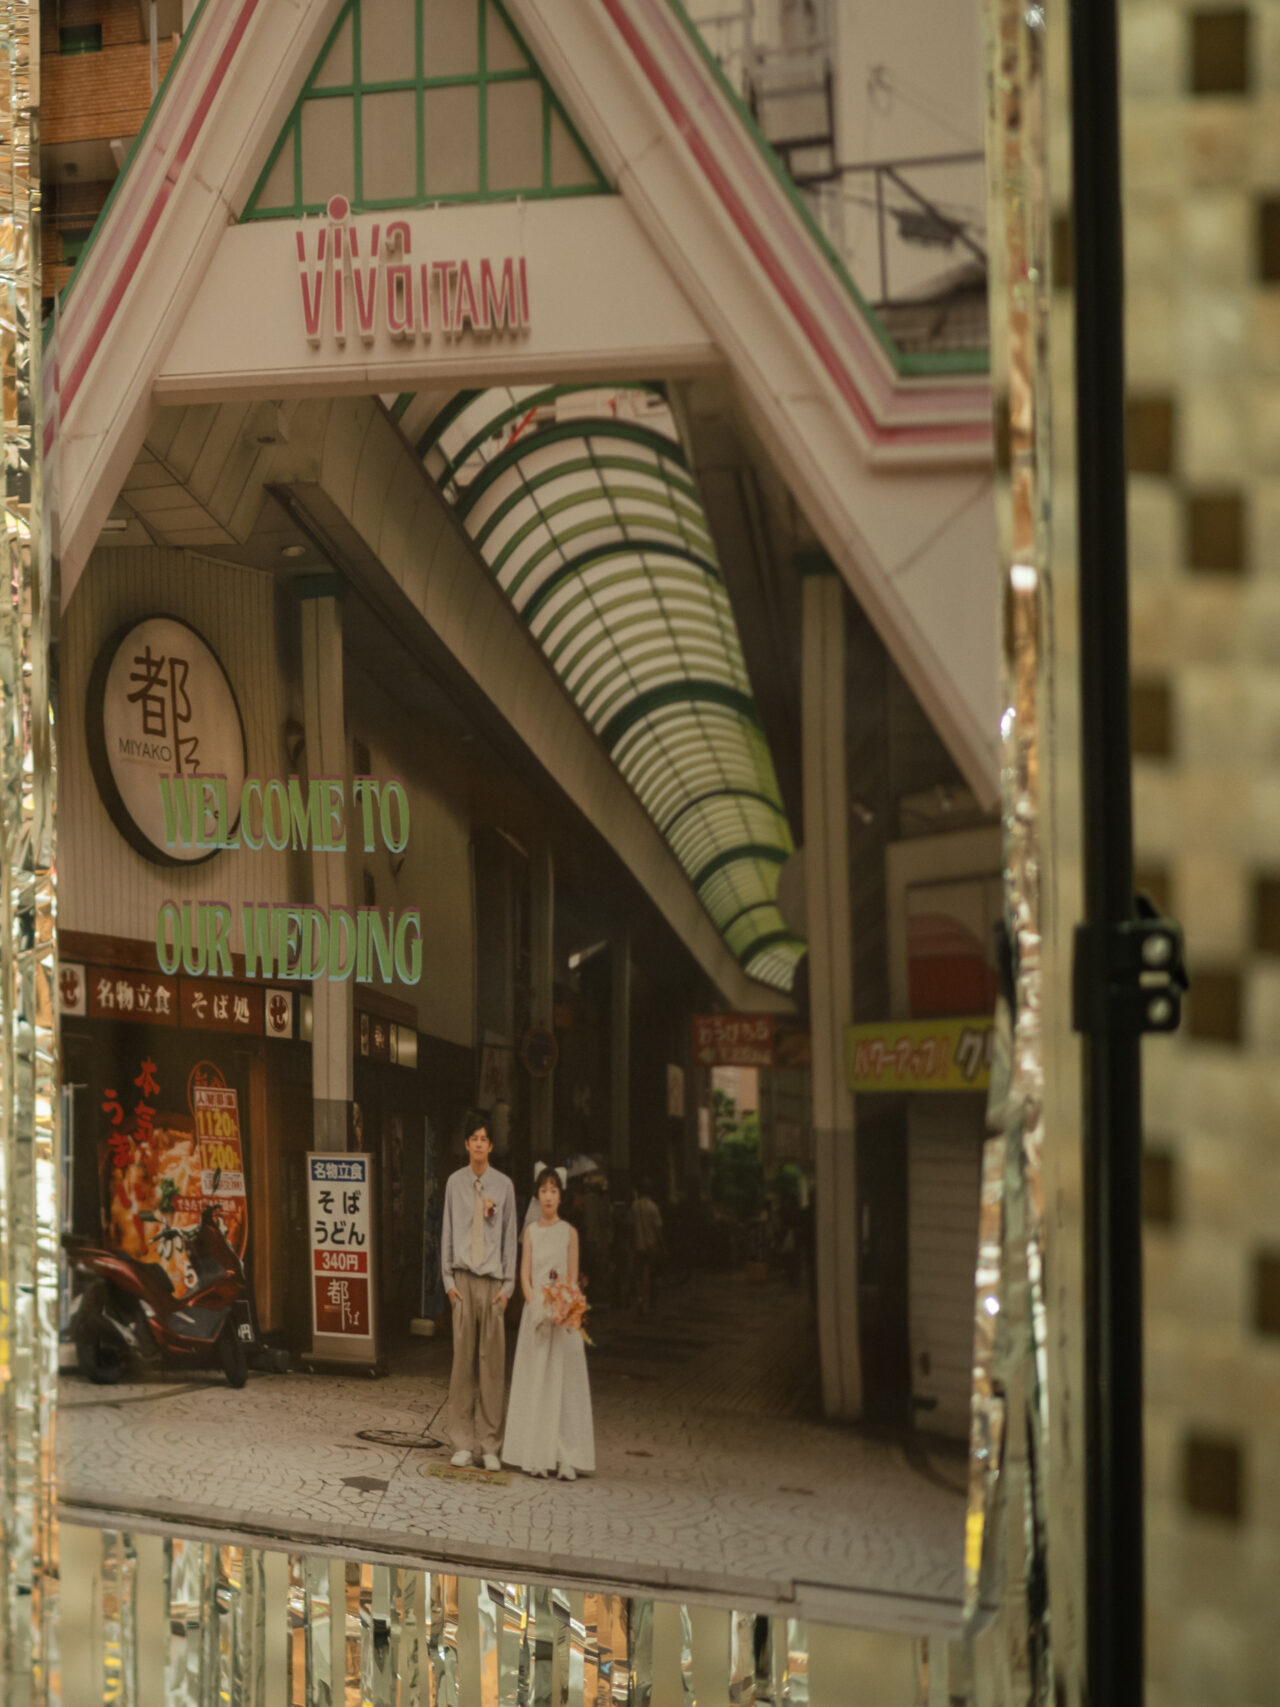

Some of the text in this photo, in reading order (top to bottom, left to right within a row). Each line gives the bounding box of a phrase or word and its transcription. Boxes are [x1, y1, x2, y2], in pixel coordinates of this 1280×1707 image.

[419, 255, 531, 335] ITAMI
[118, 736, 173, 763] MIYAKO
[158, 773, 411, 854] WELCOME TO
[155, 899, 424, 986] OUR WEDDING
[96, 977, 251, 1025] 名物立食 そば処
[313, 1161, 363, 1180] 名物立食
[317, 1189, 362, 1215] そば
[314, 1219, 366, 1246] うどん
[321, 1251, 359, 1271] 340円
